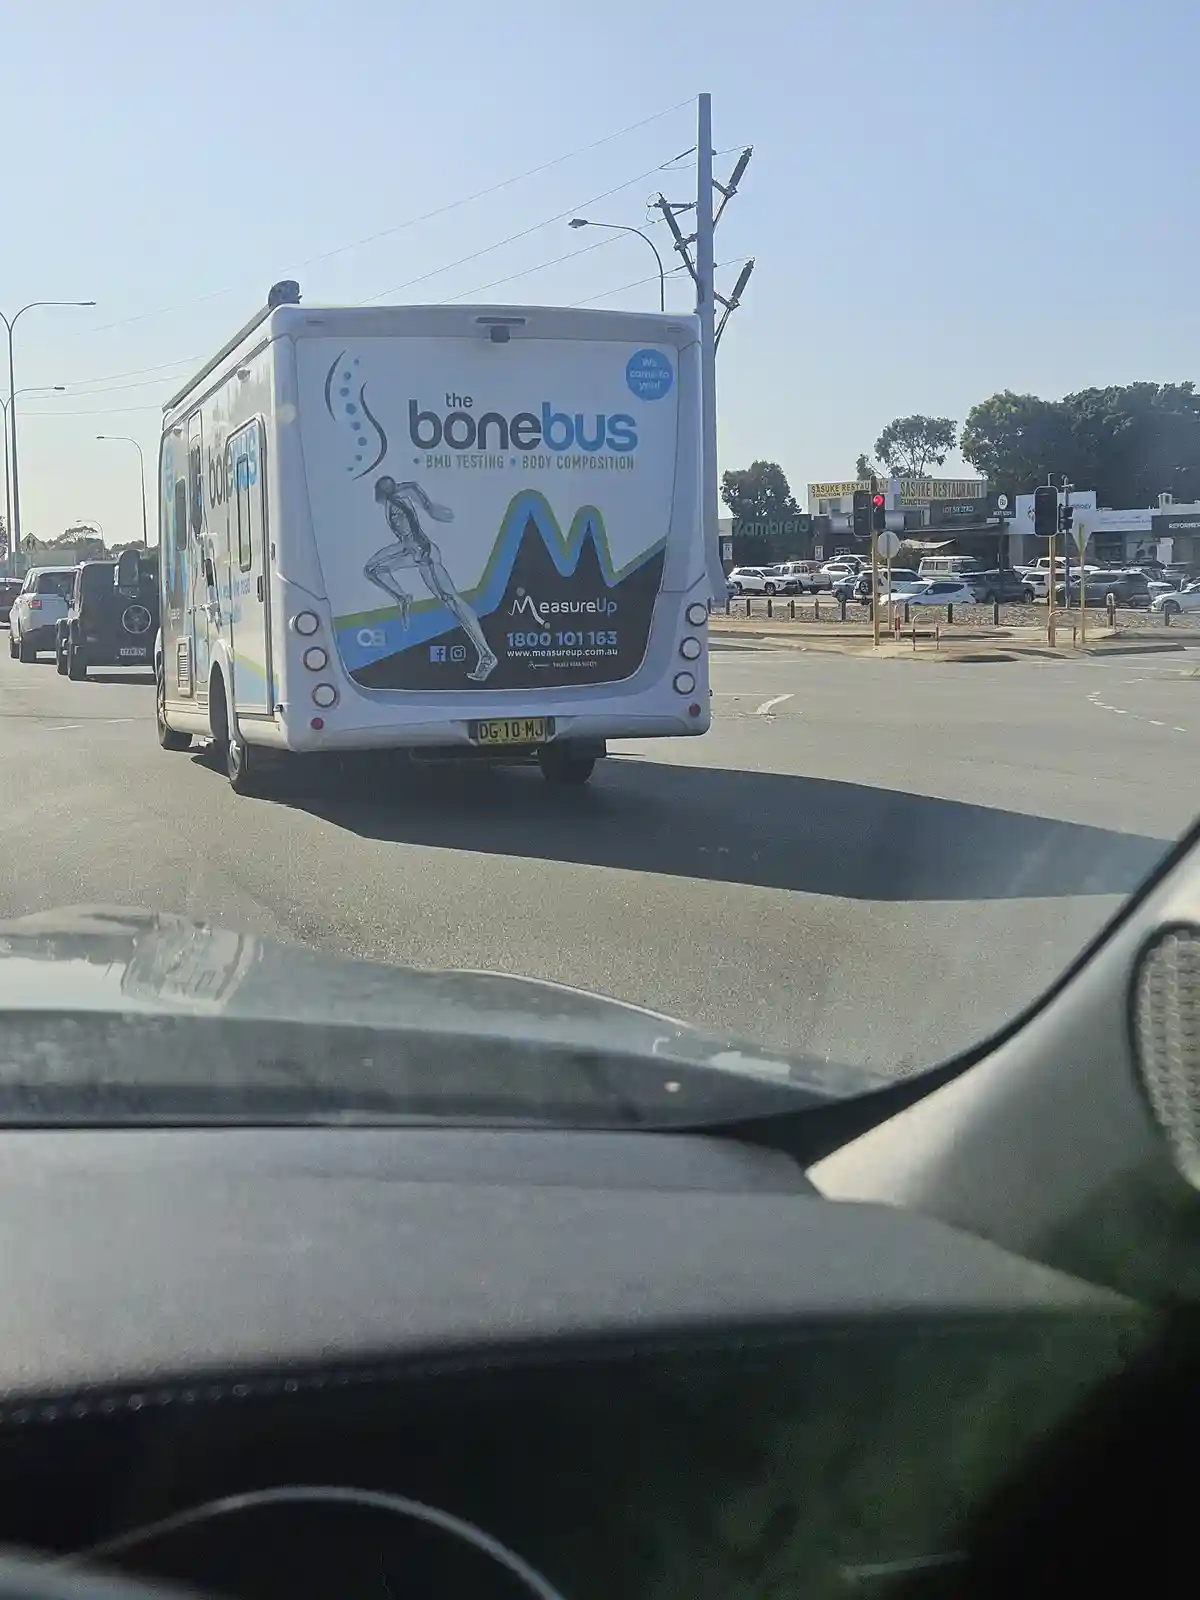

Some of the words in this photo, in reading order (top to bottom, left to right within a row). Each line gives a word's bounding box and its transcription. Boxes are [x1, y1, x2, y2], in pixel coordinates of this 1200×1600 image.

[445, 393, 473, 408] the
[408, 399, 638, 452] bonebus
[456, 455, 504, 469] TESTING
[522, 455, 552, 470] BODY
[556, 456, 634, 470] COMPOSITION
[811, 483, 840, 493] SASUKE
[841, 480, 889, 492] RESTAUNT
[900, 482, 931, 498] SASUKE
[933, 481, 981, 498] RESTAURANT
[508, 595, 617, 625] MeasureUp
[507, 632, 551, 647] 1800
[557, 631, 583, 646] 101
[587, 630, 617, 645] 163
[507, 648, 618, 658] www.measureup.com.au
